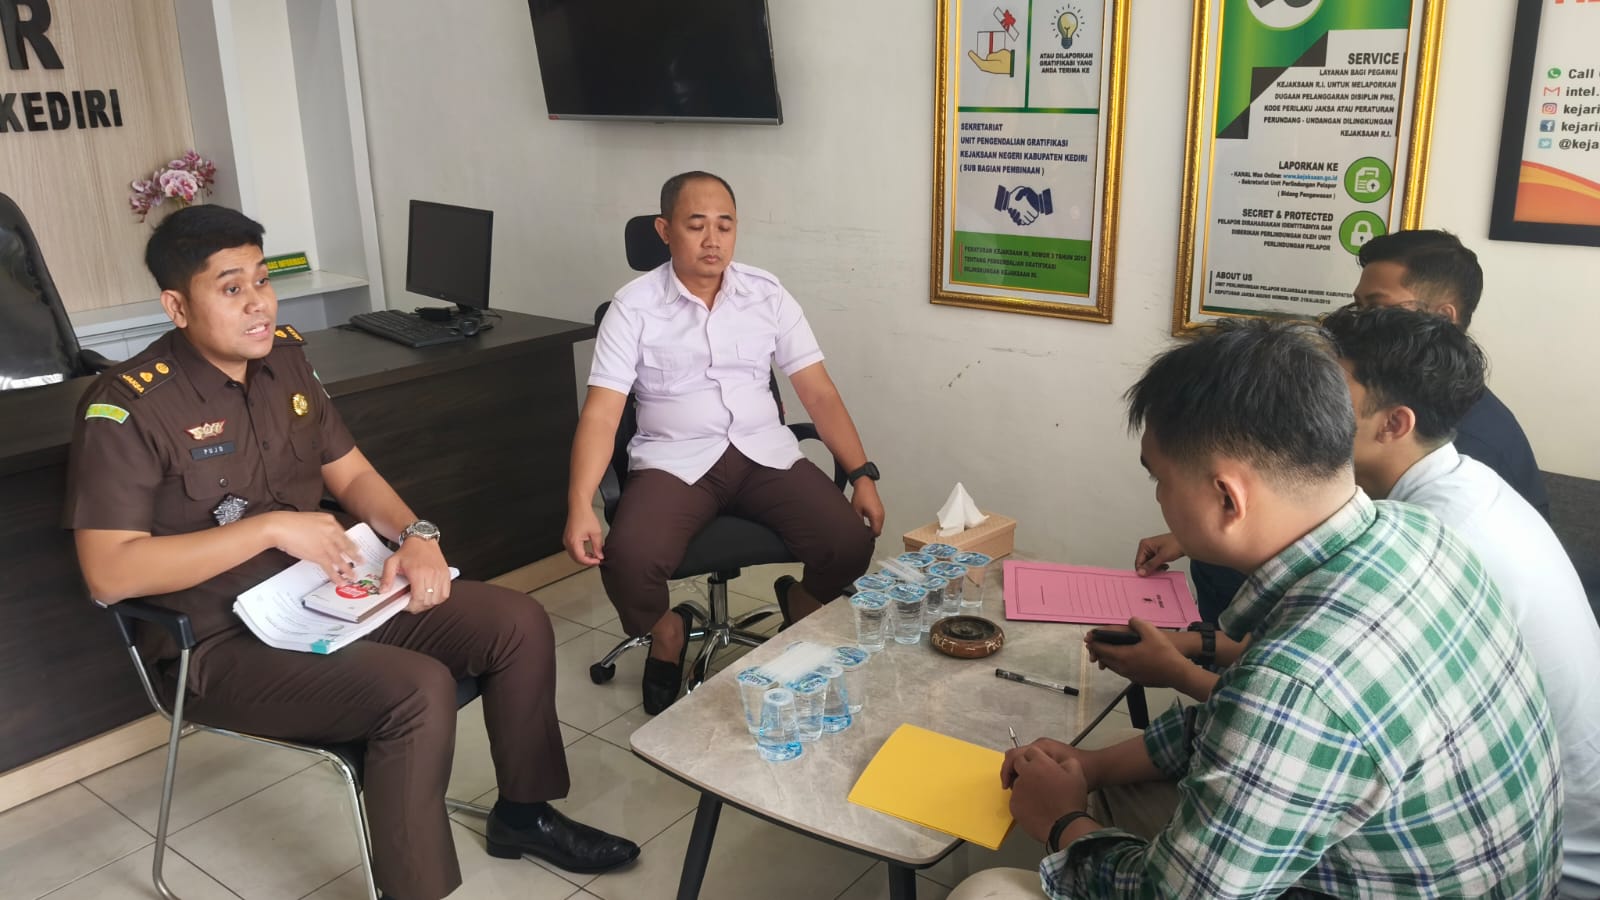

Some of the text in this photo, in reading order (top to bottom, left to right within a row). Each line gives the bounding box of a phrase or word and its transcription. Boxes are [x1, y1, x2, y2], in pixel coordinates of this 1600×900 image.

[1348, 52, 1399, 65] SERVICE
[1569, 69, 1594, 79] Call
[0, 89, 123, 133] KEDIRI
[961, 123, 1003, 131] SEKRETARIAT
[960, 136, 1068, 147] UNIT PENGENDALIAN GRATIFIKASI
[1024, 153, 1063, 161] KABUPATEN
[1064, 154, 1088, 162] KEDIRI
[1279, 161, 1339, 171] LAPORKAN KE
[1242, 209, 1334, 222] SECRET & PROTECTED
[1216, 272, 1241, 280] ABOUT
